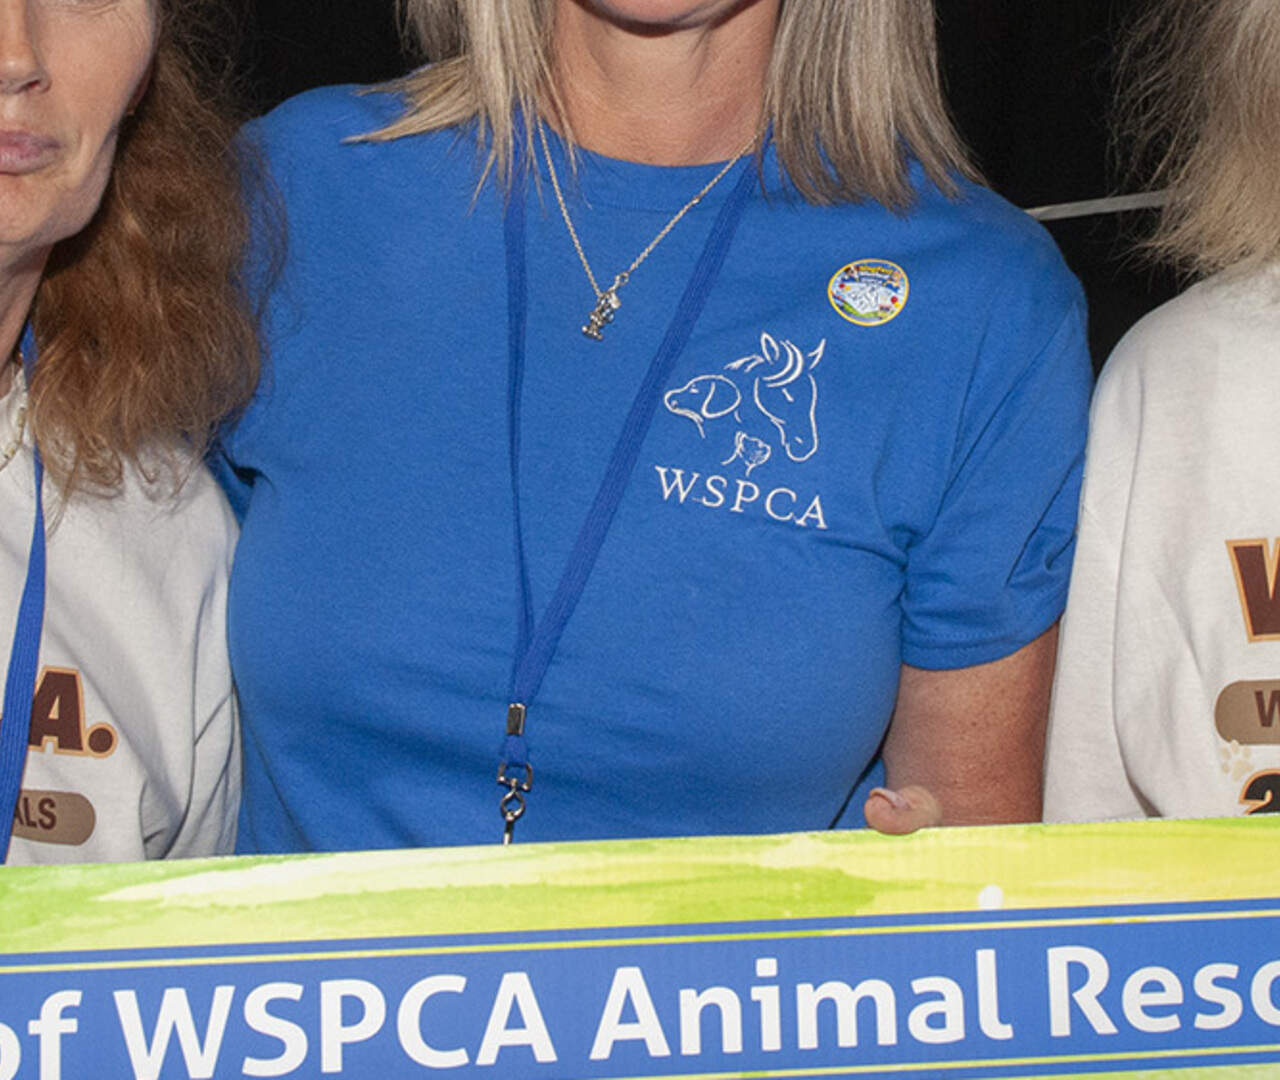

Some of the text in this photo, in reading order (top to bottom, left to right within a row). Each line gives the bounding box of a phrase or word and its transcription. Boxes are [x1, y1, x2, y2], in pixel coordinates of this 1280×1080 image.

[654, 465, 828, 529] WSPCA
[113, 970, 558, 1080] WSPCA
[589, 948, 1013, 1061] Animal
